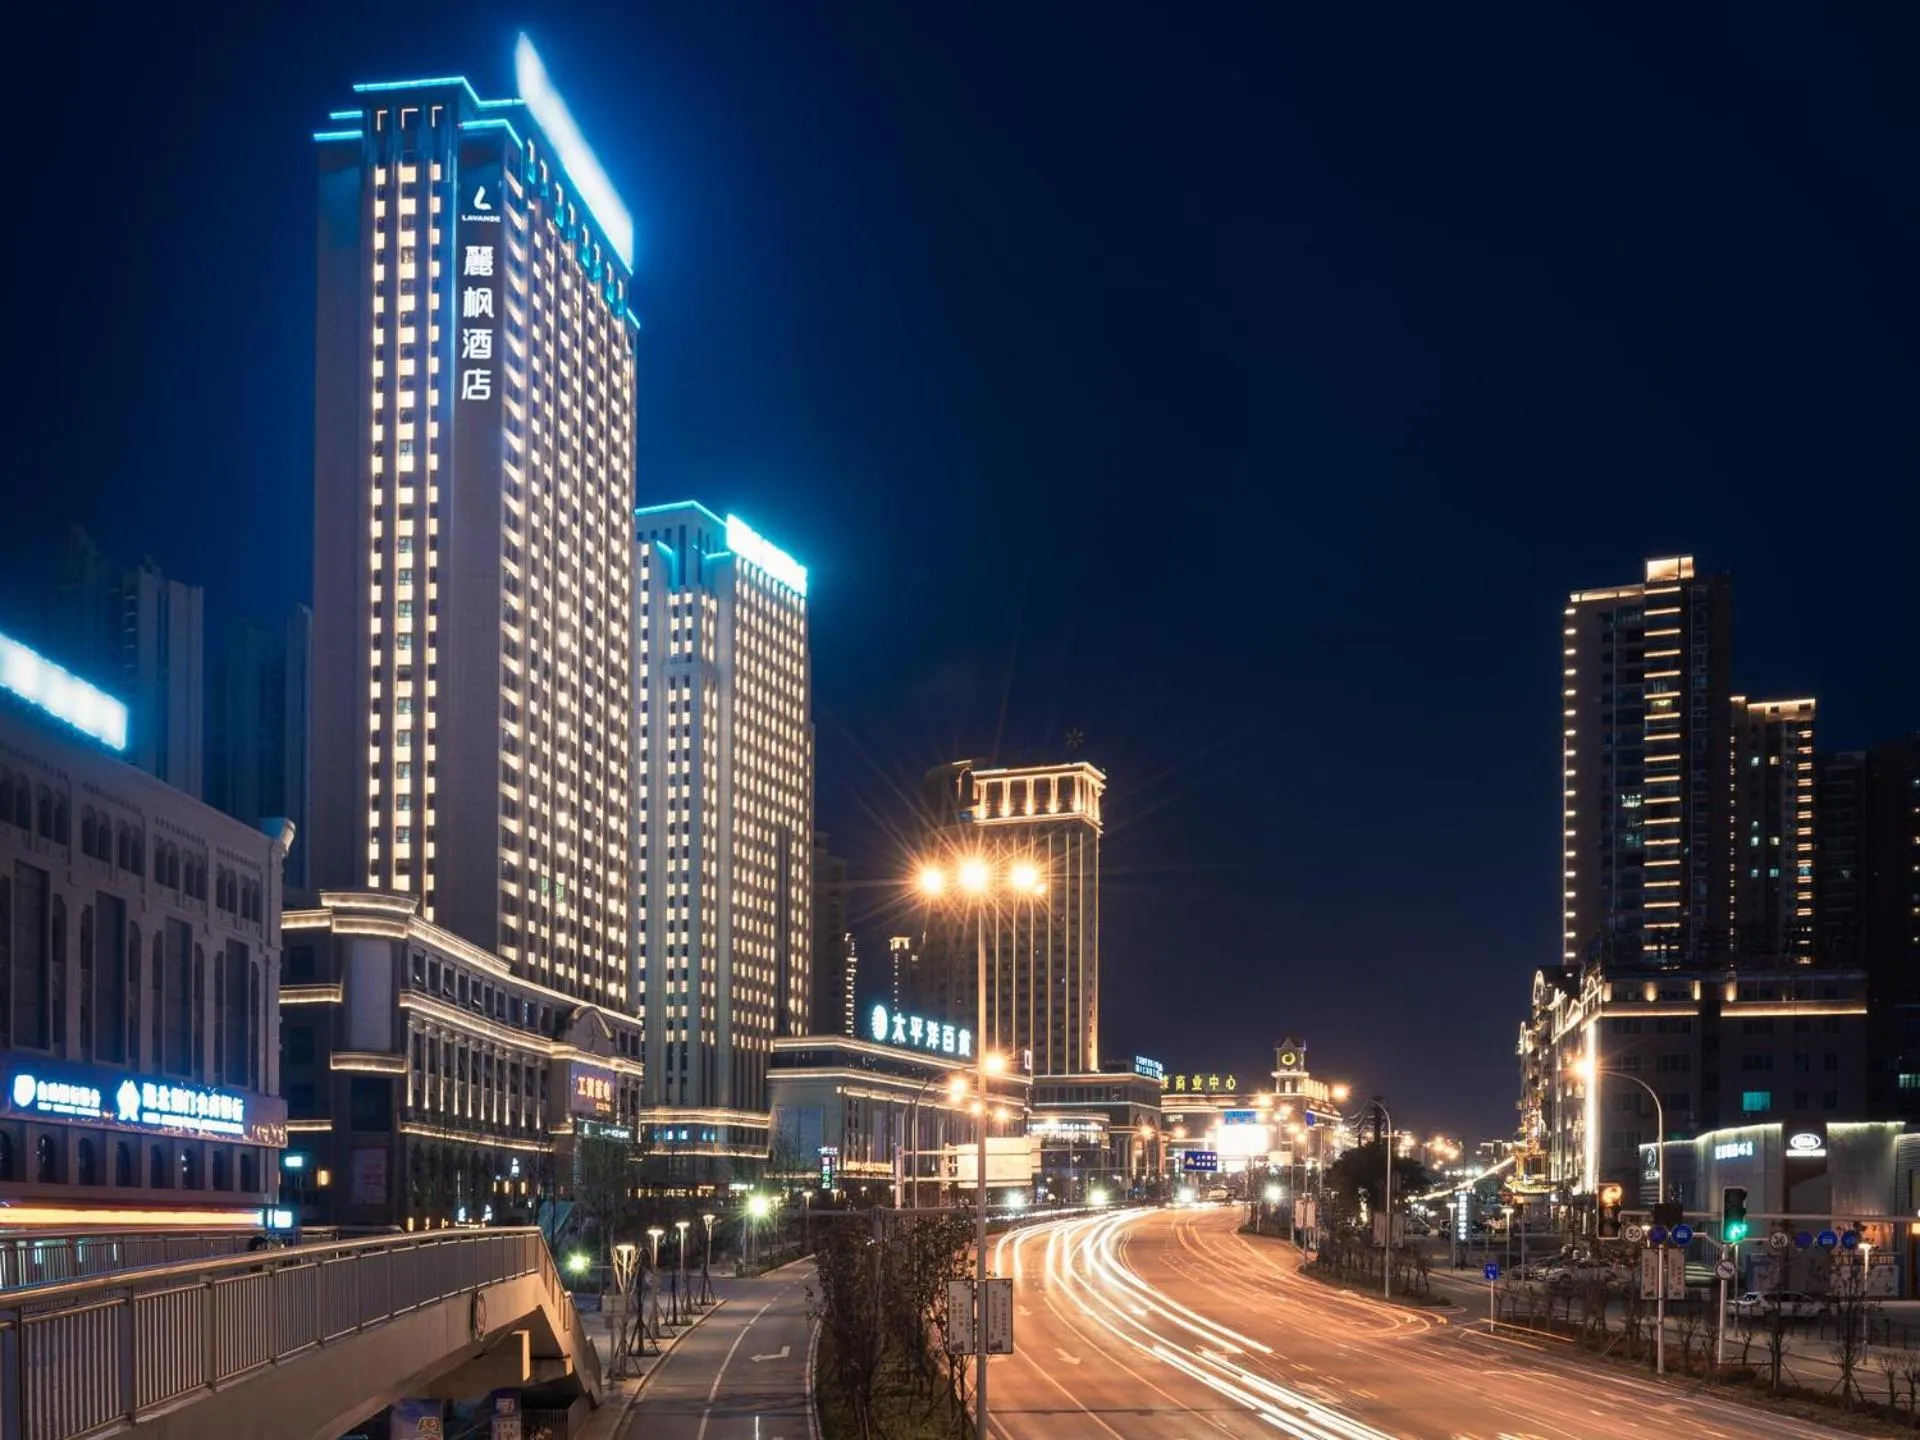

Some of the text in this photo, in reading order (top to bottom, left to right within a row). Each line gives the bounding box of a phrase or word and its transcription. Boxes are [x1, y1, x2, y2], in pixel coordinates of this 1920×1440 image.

[462, 245, 495, 401] 麗枫酒店
[1628, 1229, 1640, 1238] 50
